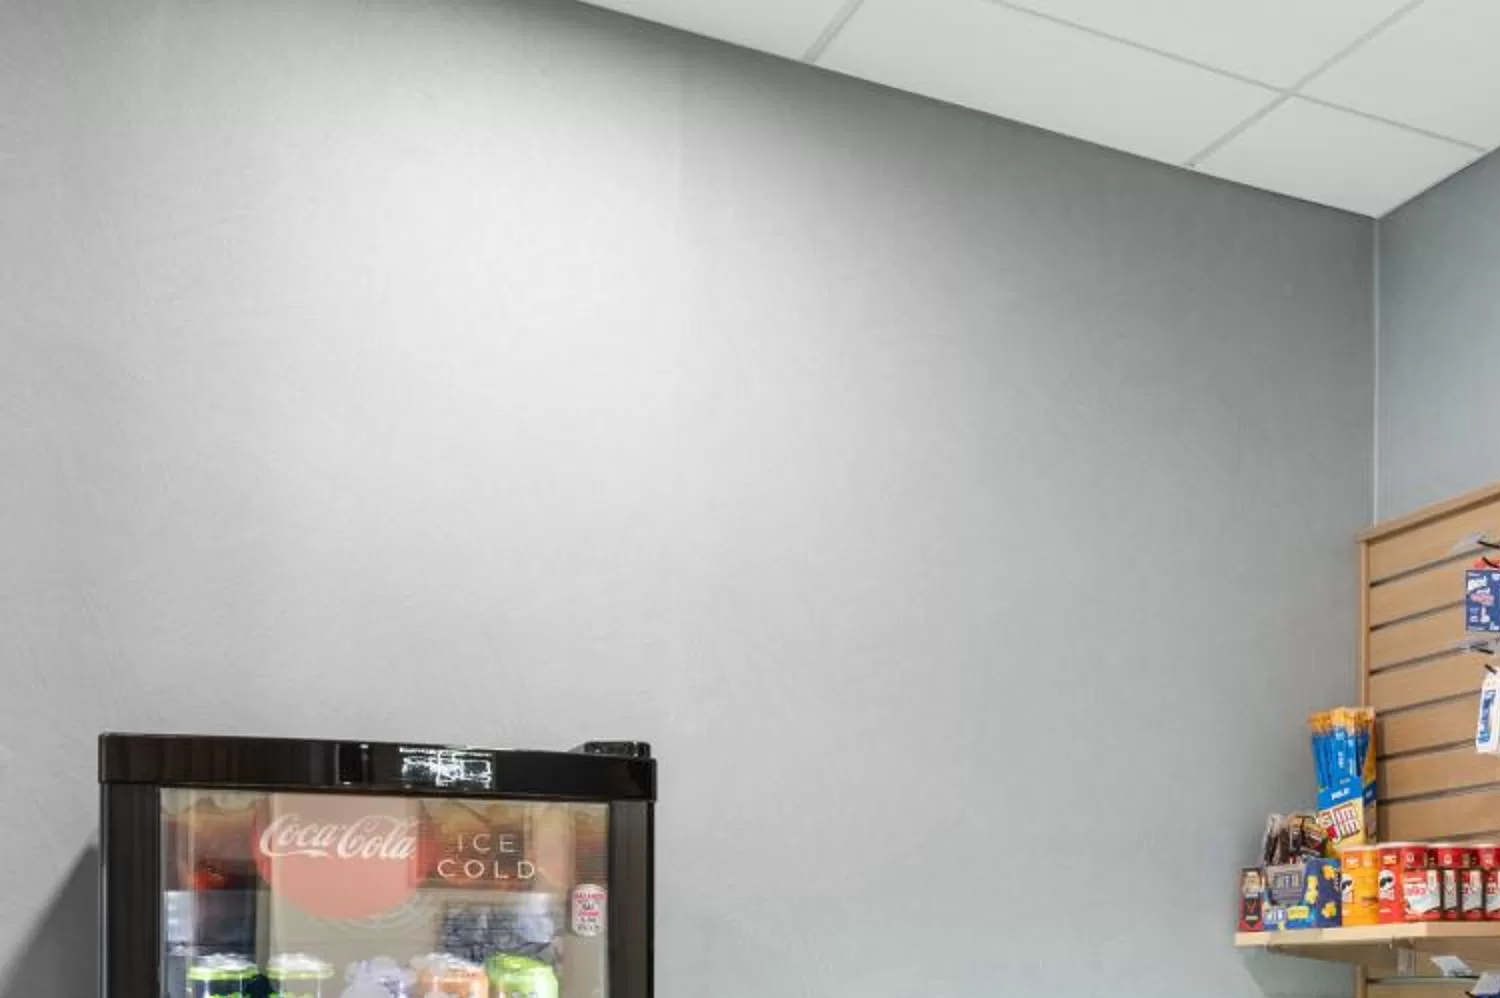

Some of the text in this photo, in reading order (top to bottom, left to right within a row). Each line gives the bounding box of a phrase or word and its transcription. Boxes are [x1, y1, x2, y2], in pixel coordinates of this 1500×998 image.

[258, 813, 420, 861] Coca-Cola
[457, 832, 519, 854] ICE
[436, 858, 537, 880] COLD
